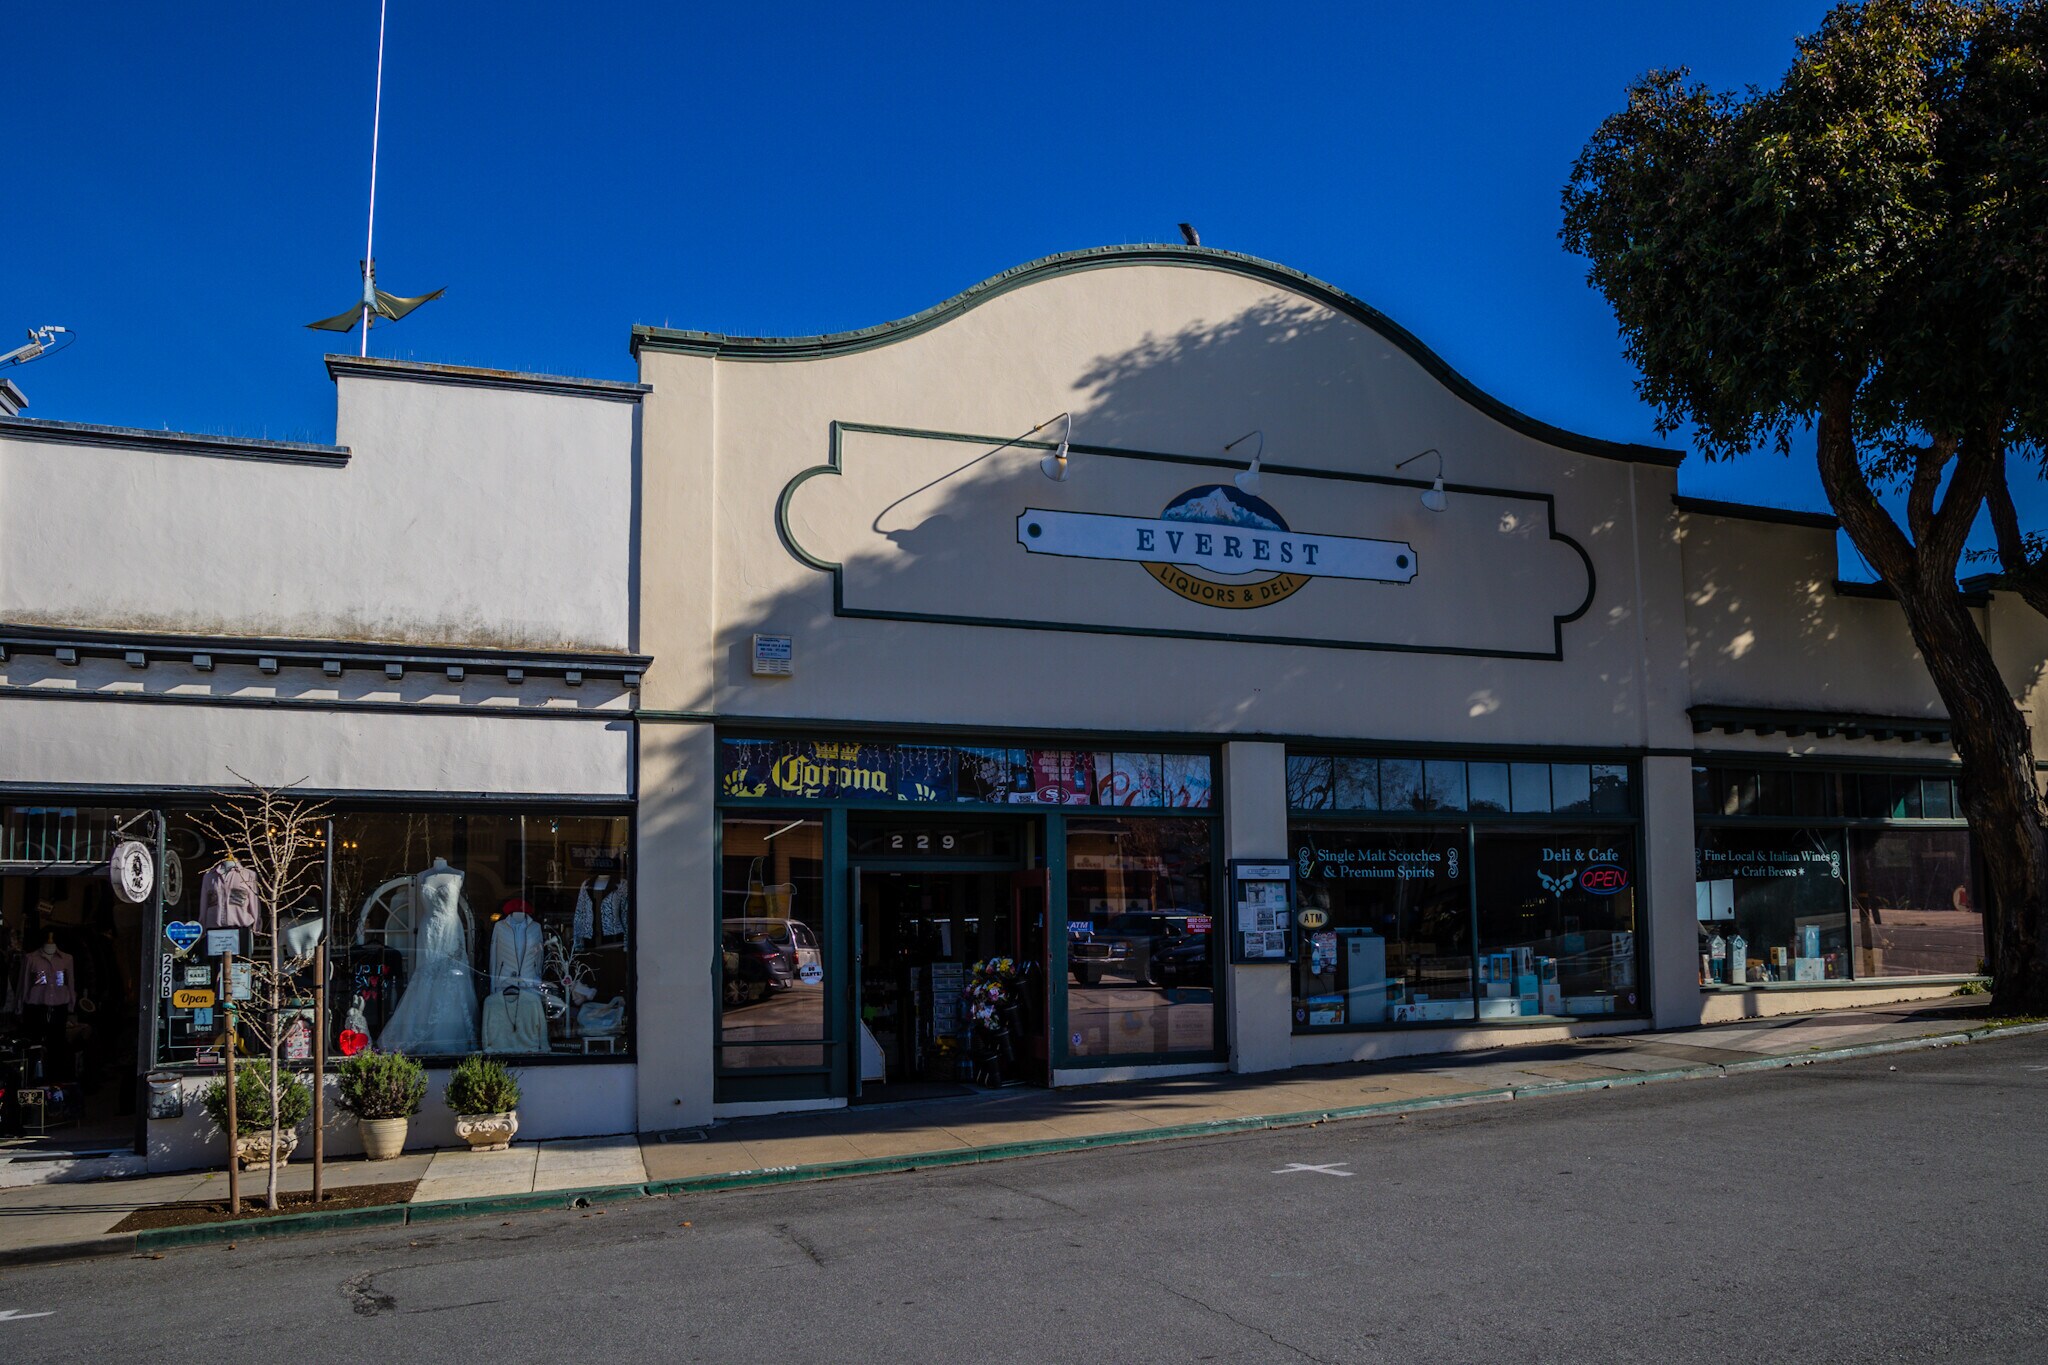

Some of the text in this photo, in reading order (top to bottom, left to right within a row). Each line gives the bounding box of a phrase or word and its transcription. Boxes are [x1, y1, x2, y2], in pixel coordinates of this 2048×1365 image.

[1137, 528, 1318, 565] EVEREST
[1160, 567, 1294, 602] LIQUORS & DELI
[772, 754, 888, 796] Corona
[1318, 849, 1441, 863] Single Malt Scotches
[1542, 848, 1619, 861] Deli & Cafe
[1705, 850, 1830, 861] Fine Local & Italian Wines
[1324, 865, 1435, 880] & Premium Spirits
[1741, 865, 1797, 877] Craft Brews
[1582, 870, 1628, 887] OPEN
[1304, 914, 1322, 923] ATM
[163, 954, 172, 997] 229B
[180, 993, 208, 1005] Open
